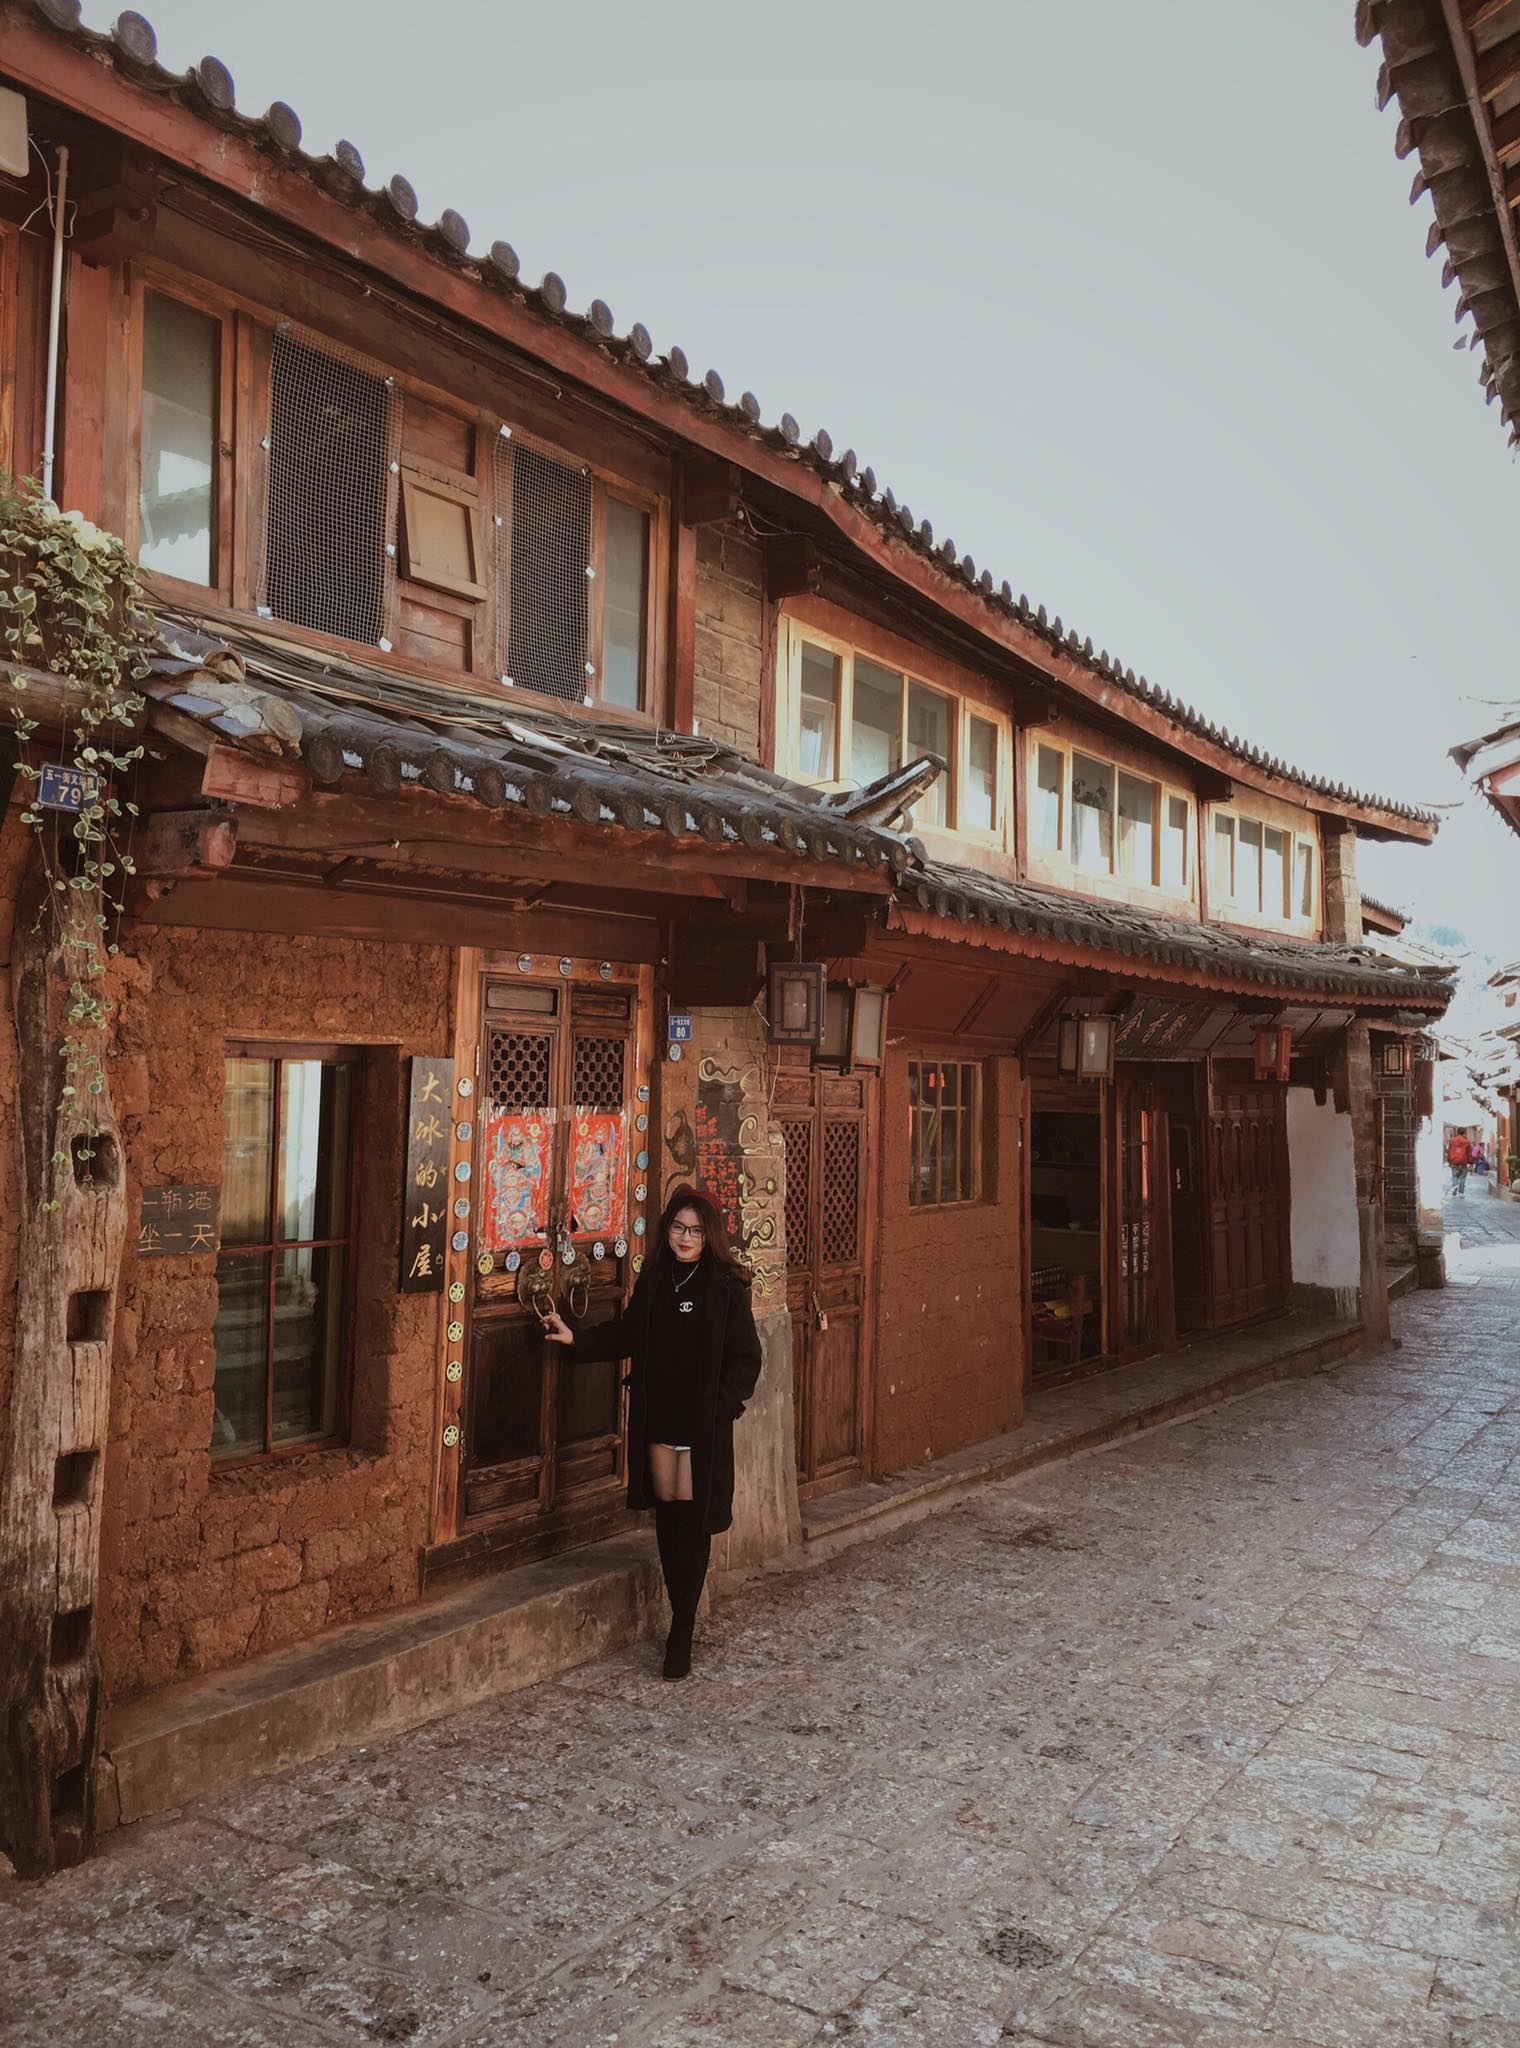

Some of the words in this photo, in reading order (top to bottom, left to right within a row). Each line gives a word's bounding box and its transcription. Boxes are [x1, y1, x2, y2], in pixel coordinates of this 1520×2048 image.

[58, 784, 81, 805] 79
[676, 1026, 686, 1038] 80
[409, 1071, 444, 1278] 大冰的小屋
[142, 1189, 212, 1220] 一瓶酒
[138, 1223, 216, 1252] 坐一天
